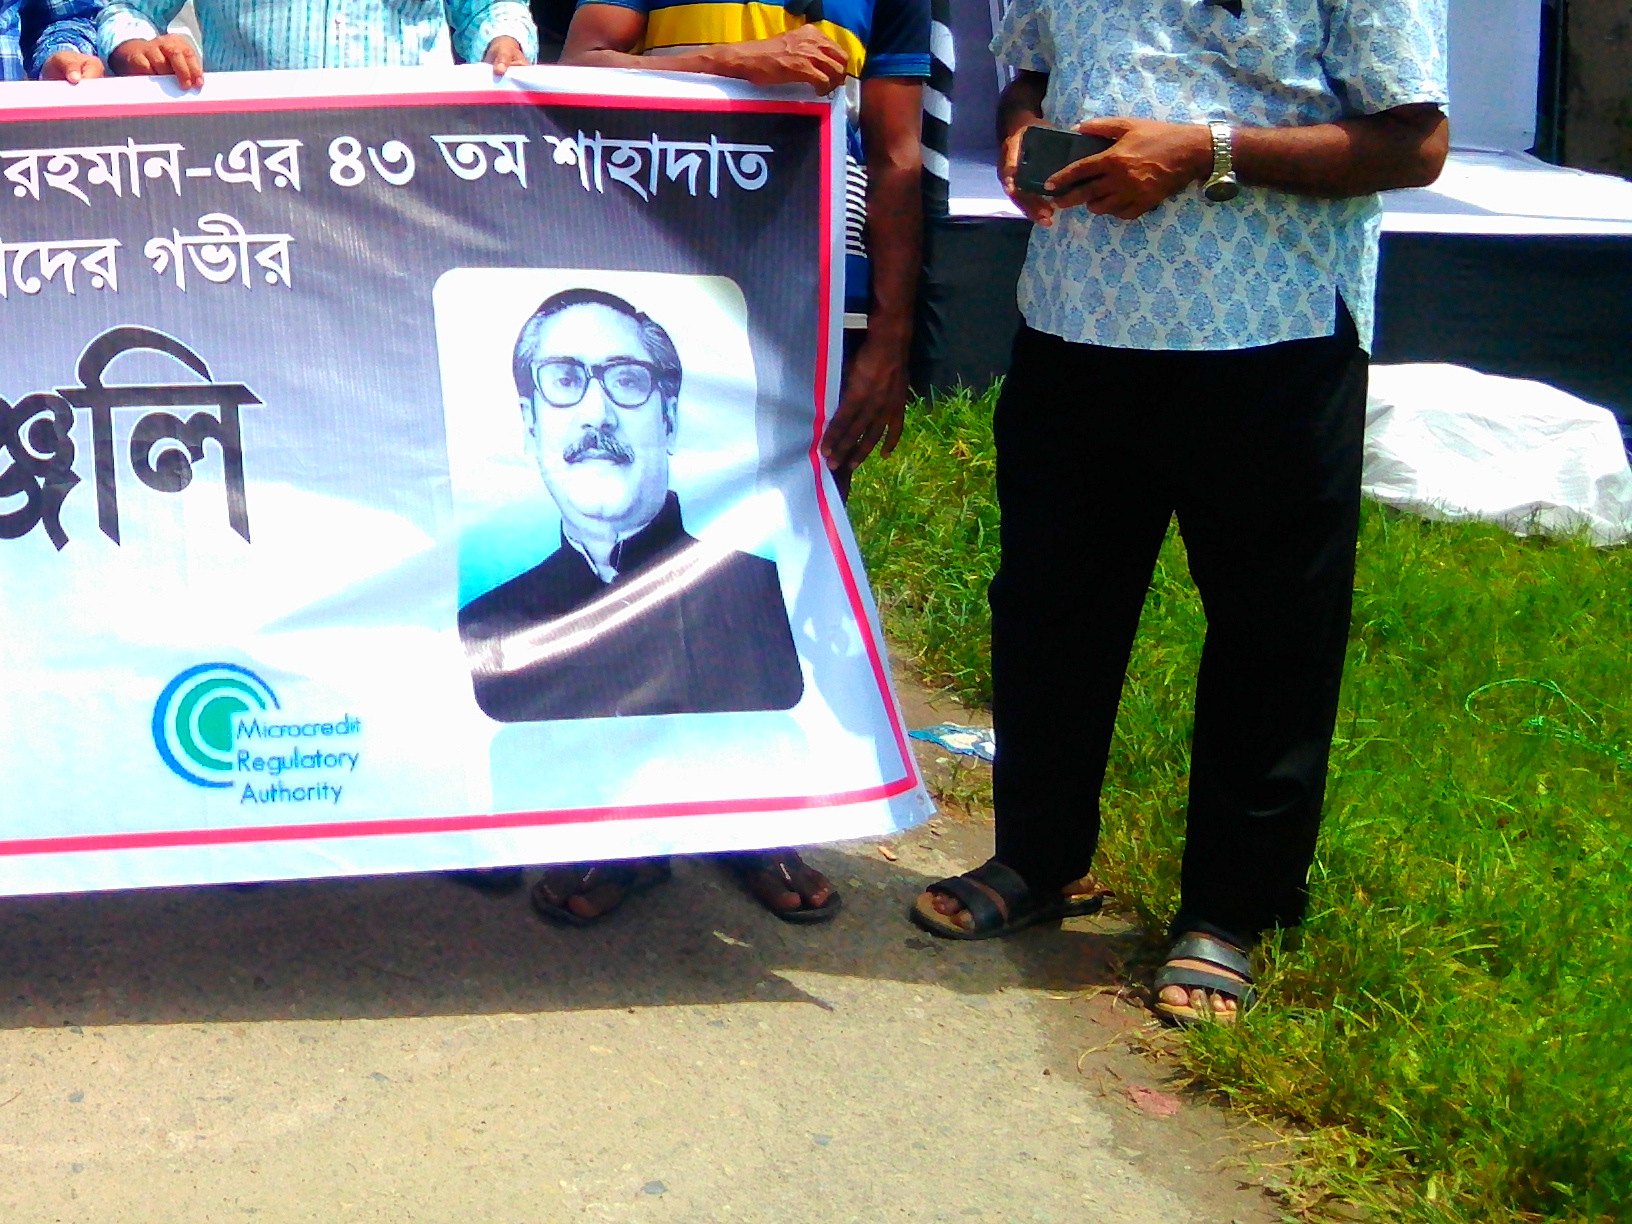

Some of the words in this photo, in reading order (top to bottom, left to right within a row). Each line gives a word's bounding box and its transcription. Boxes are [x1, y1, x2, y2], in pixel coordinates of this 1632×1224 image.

[328, 135, 416, 187] ৪৩
[430, 134, 531, 190] তম
[550, 129, 774, 202] শাহাদাত
[143, 212, 296, 293] গভীর
[236, 713, 362, 740] Microcredit
[236, 746, 360, 775] Regulatory
[240, 780, 343, 806] Authority
